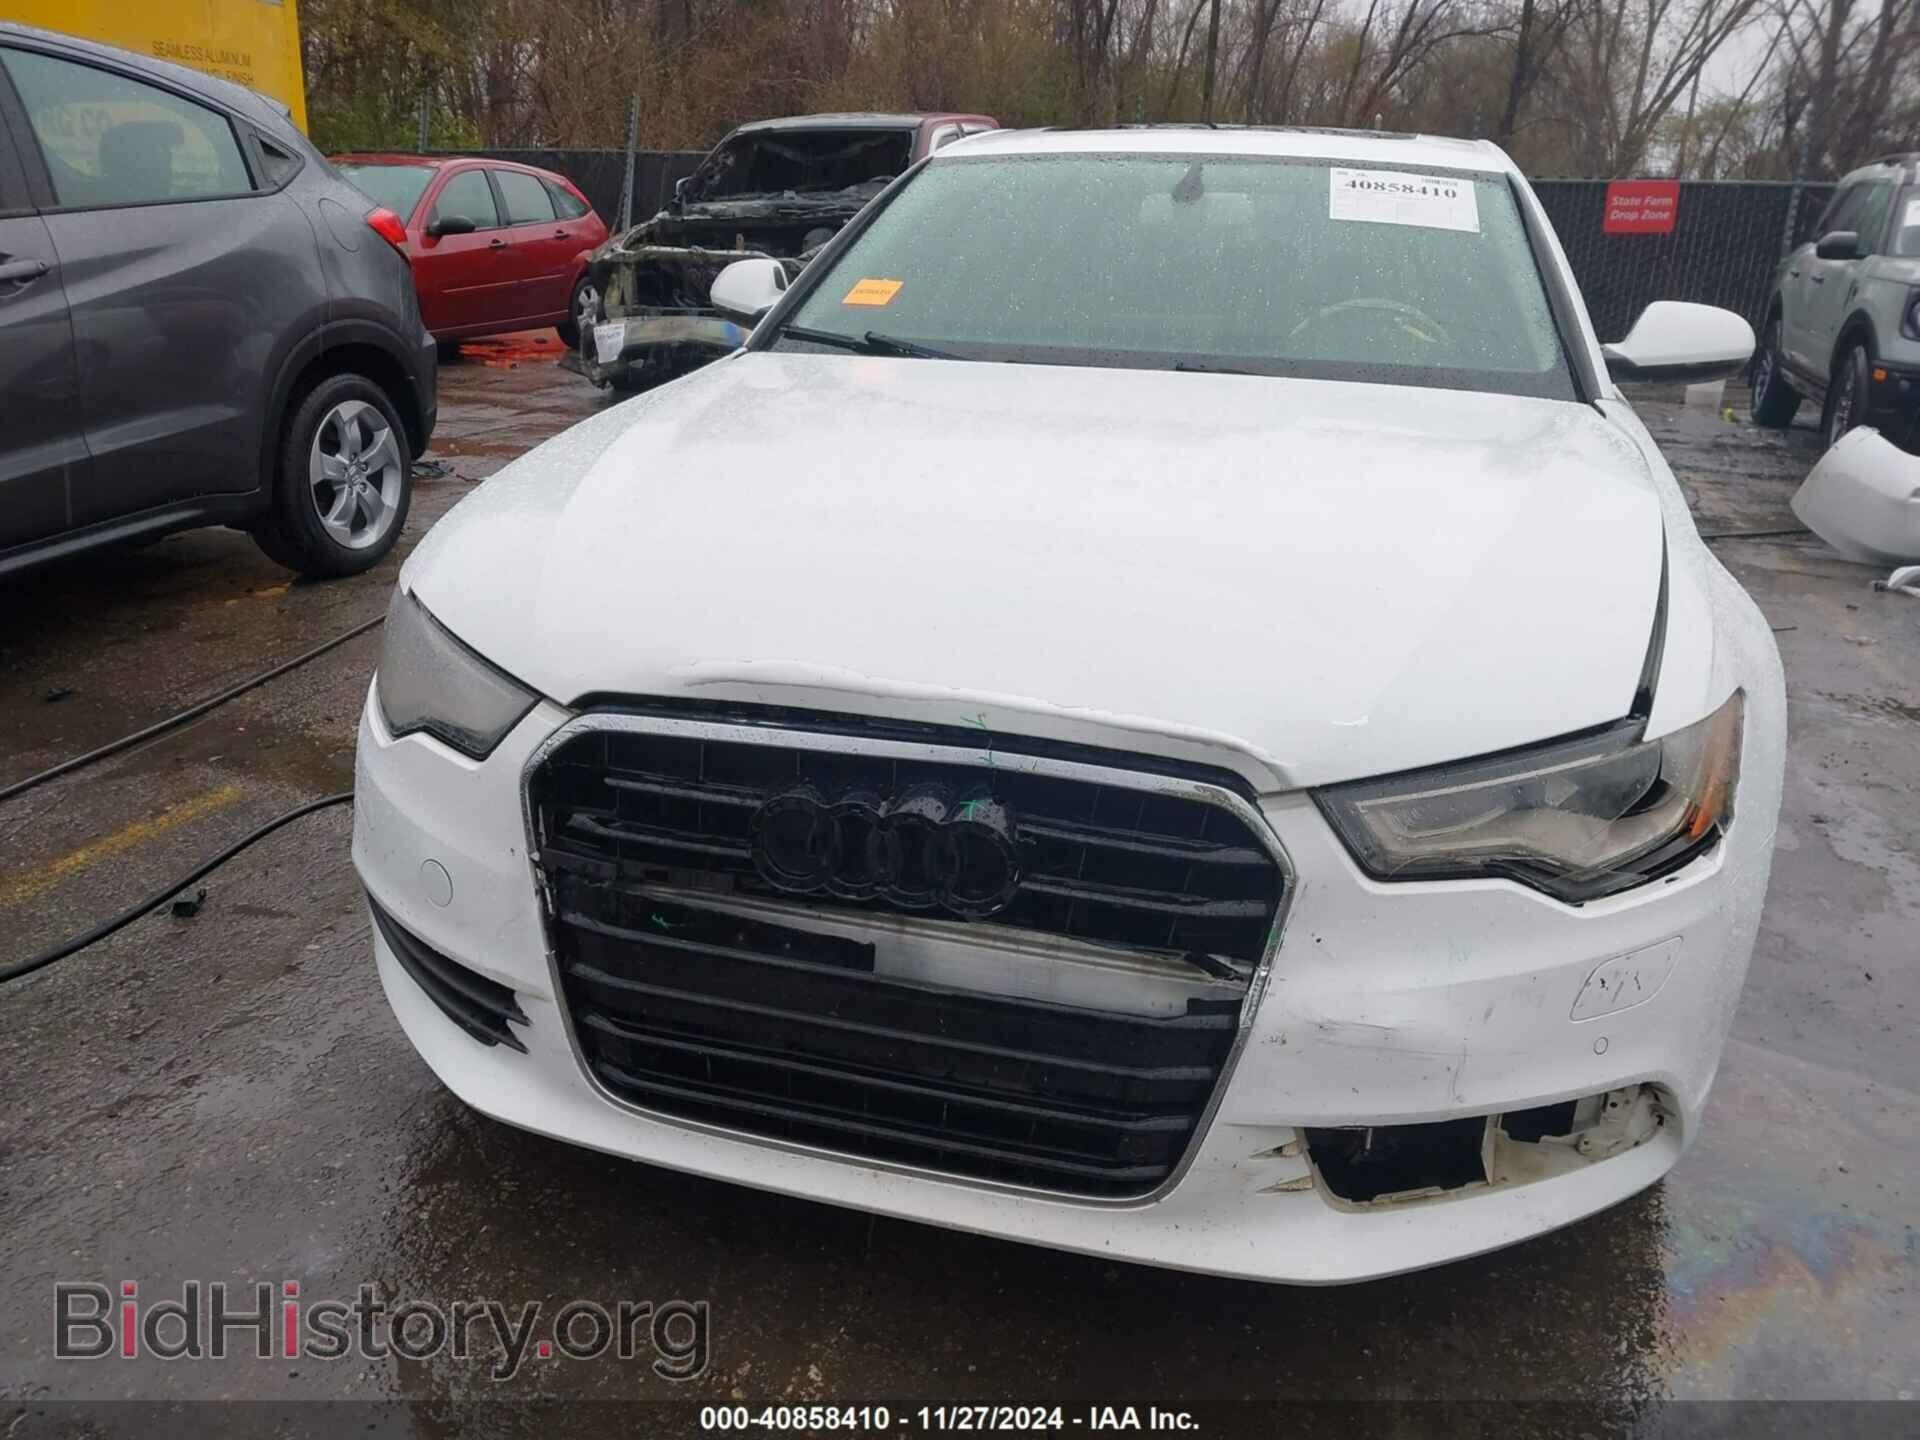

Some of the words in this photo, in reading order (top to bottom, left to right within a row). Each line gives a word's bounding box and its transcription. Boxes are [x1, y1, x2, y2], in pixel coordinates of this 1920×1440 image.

[1344, 179, 1457, 199] 40858410
[1610, 195, 1642, 207] State
[1643, 195, 1673, 207] Farm
[1609, 209, 1640, 222] Drop
[1640, 208, 1671, 220] Zone
